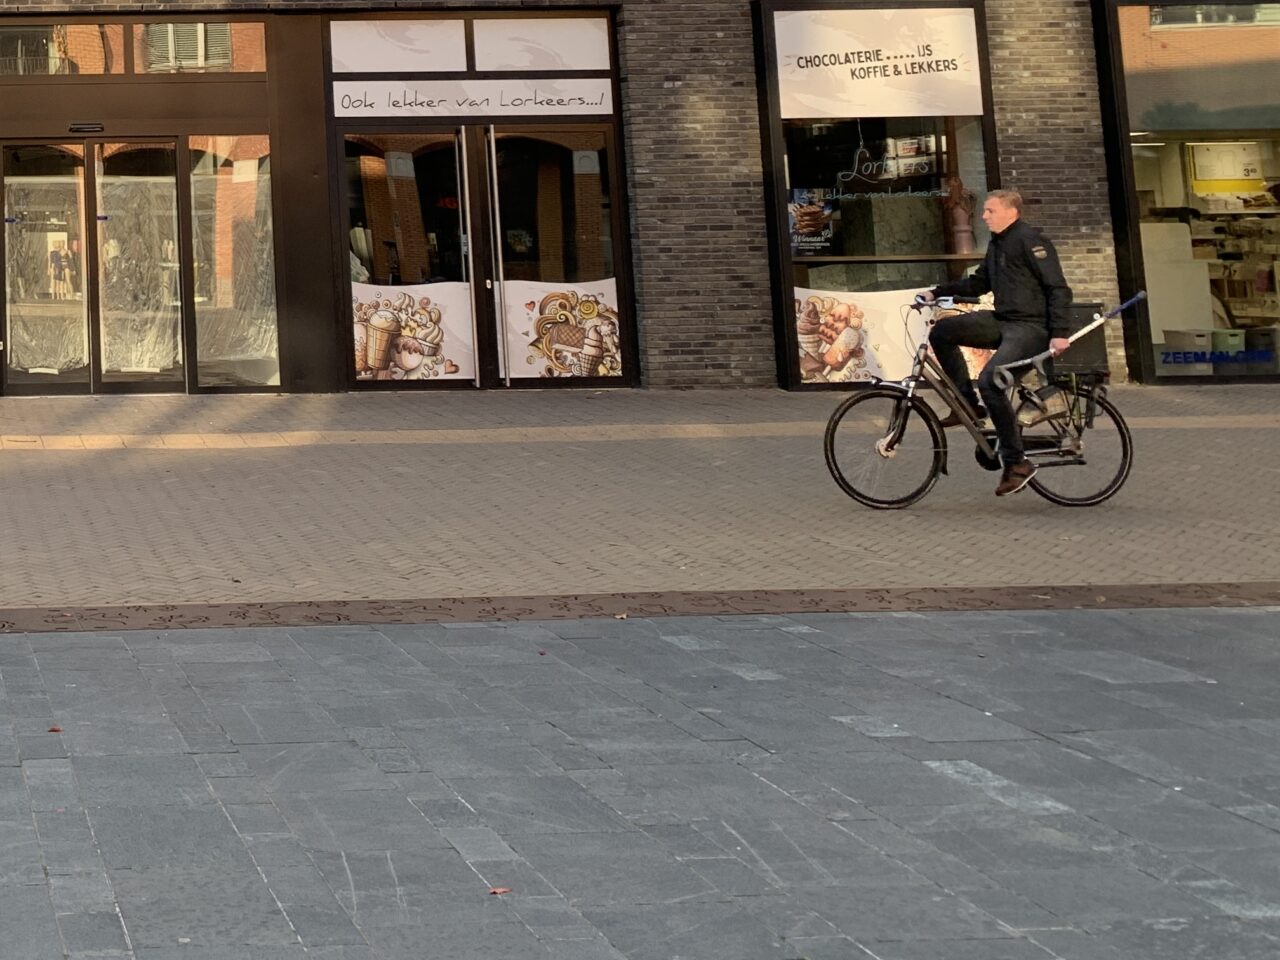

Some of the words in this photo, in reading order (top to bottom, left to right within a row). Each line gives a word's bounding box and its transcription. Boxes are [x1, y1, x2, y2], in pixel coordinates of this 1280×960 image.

[796, 49, 883, 69] CHOCOLATERIE
[917, 44, 933, 58] IJS
[850, 64, 890, 80] KOFFIE
[893, 64, 903, 76] &
[904, 58, 959, 75] LEKKERS
[341, 91, 376, 109] Ook
[387, 90, 447, 108] lekker
[455, 97, 490, 107] van
